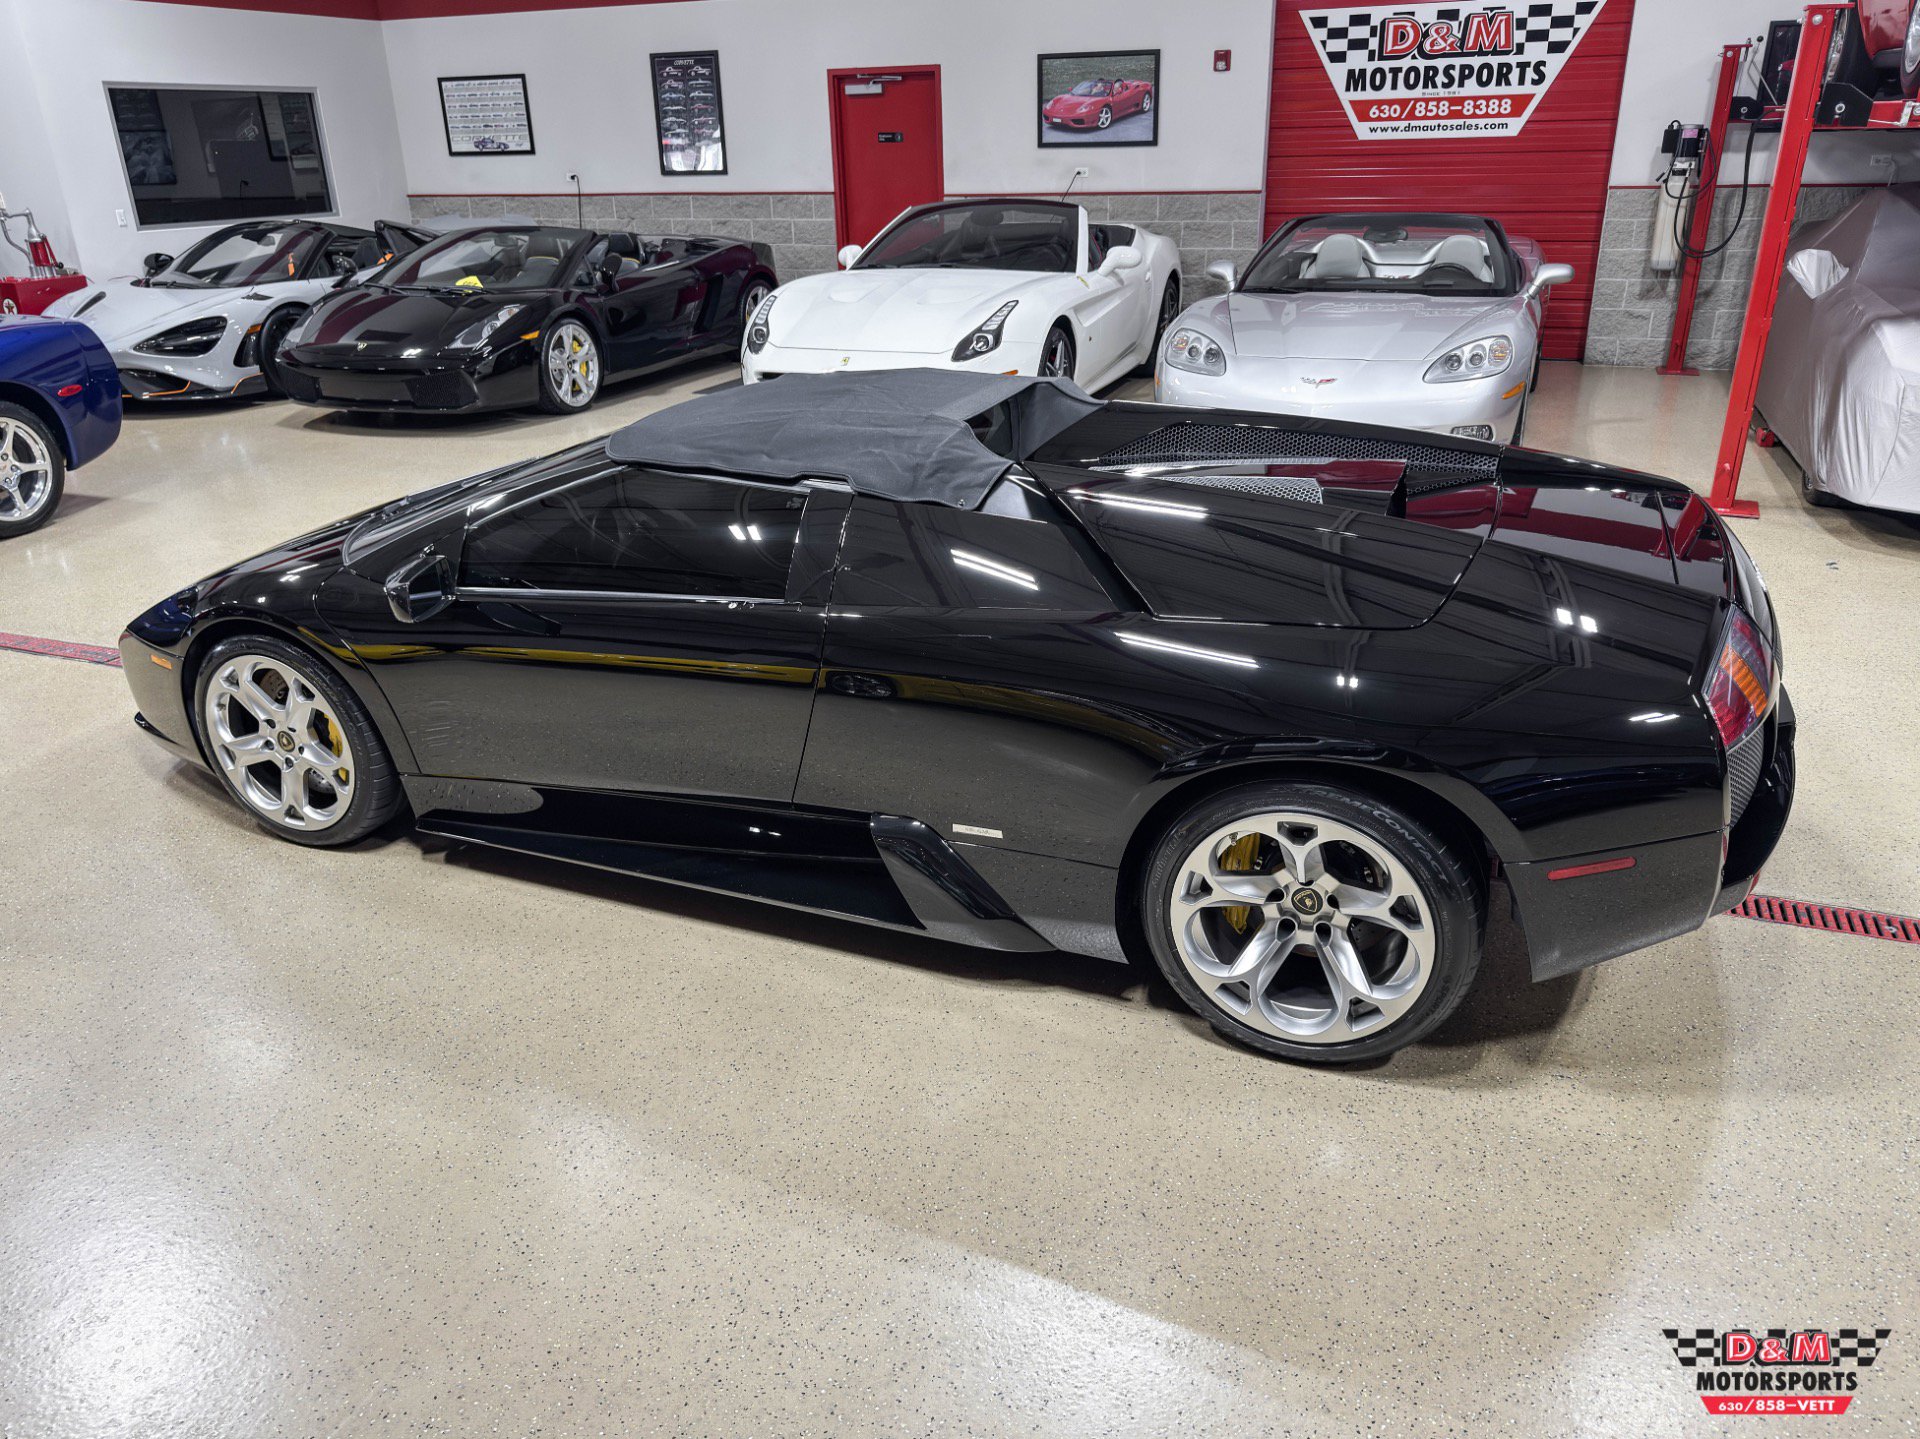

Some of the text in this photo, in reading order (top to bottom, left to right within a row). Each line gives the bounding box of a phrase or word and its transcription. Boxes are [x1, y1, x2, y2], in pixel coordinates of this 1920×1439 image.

[1380, 11, 1516, 58] D&M
[1345, 60, 1547, 92] MOTORSPORTS
[1368, 98, 1512, 119] 630/858-8388
[1368, 120, 1509, 134] www.dmautosales.com
